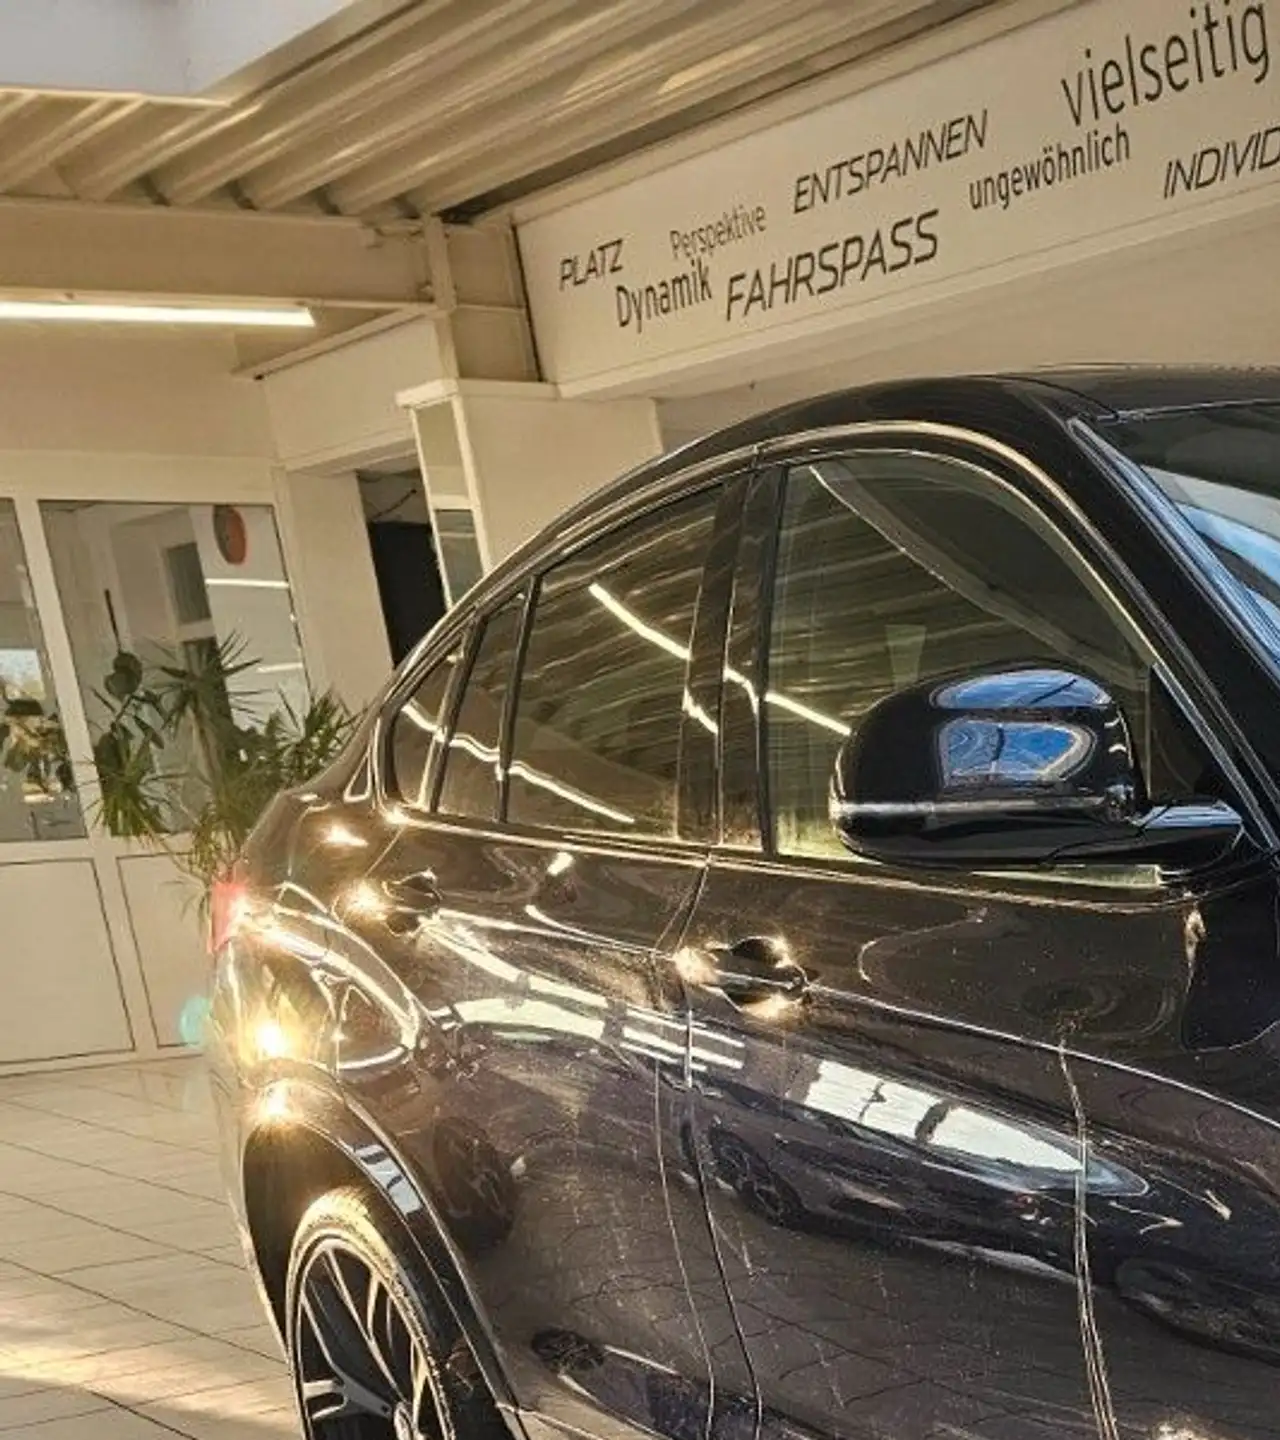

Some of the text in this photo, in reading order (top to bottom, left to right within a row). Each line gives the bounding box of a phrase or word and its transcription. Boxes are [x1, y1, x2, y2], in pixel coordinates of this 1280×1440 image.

[1060, 0, 1269, 127] vielseitig
[793, 109, 987, 214] ENTSPANNEN
[970, 123, 1130, 210] ungewöhnlich
[560, 238, 623, 290] PLATZ
[670, 206, 766, 260] Perspektive
[726, 208, 939, 322] FAHRSPASS
[616, 260, 712, 334] Dynamik
